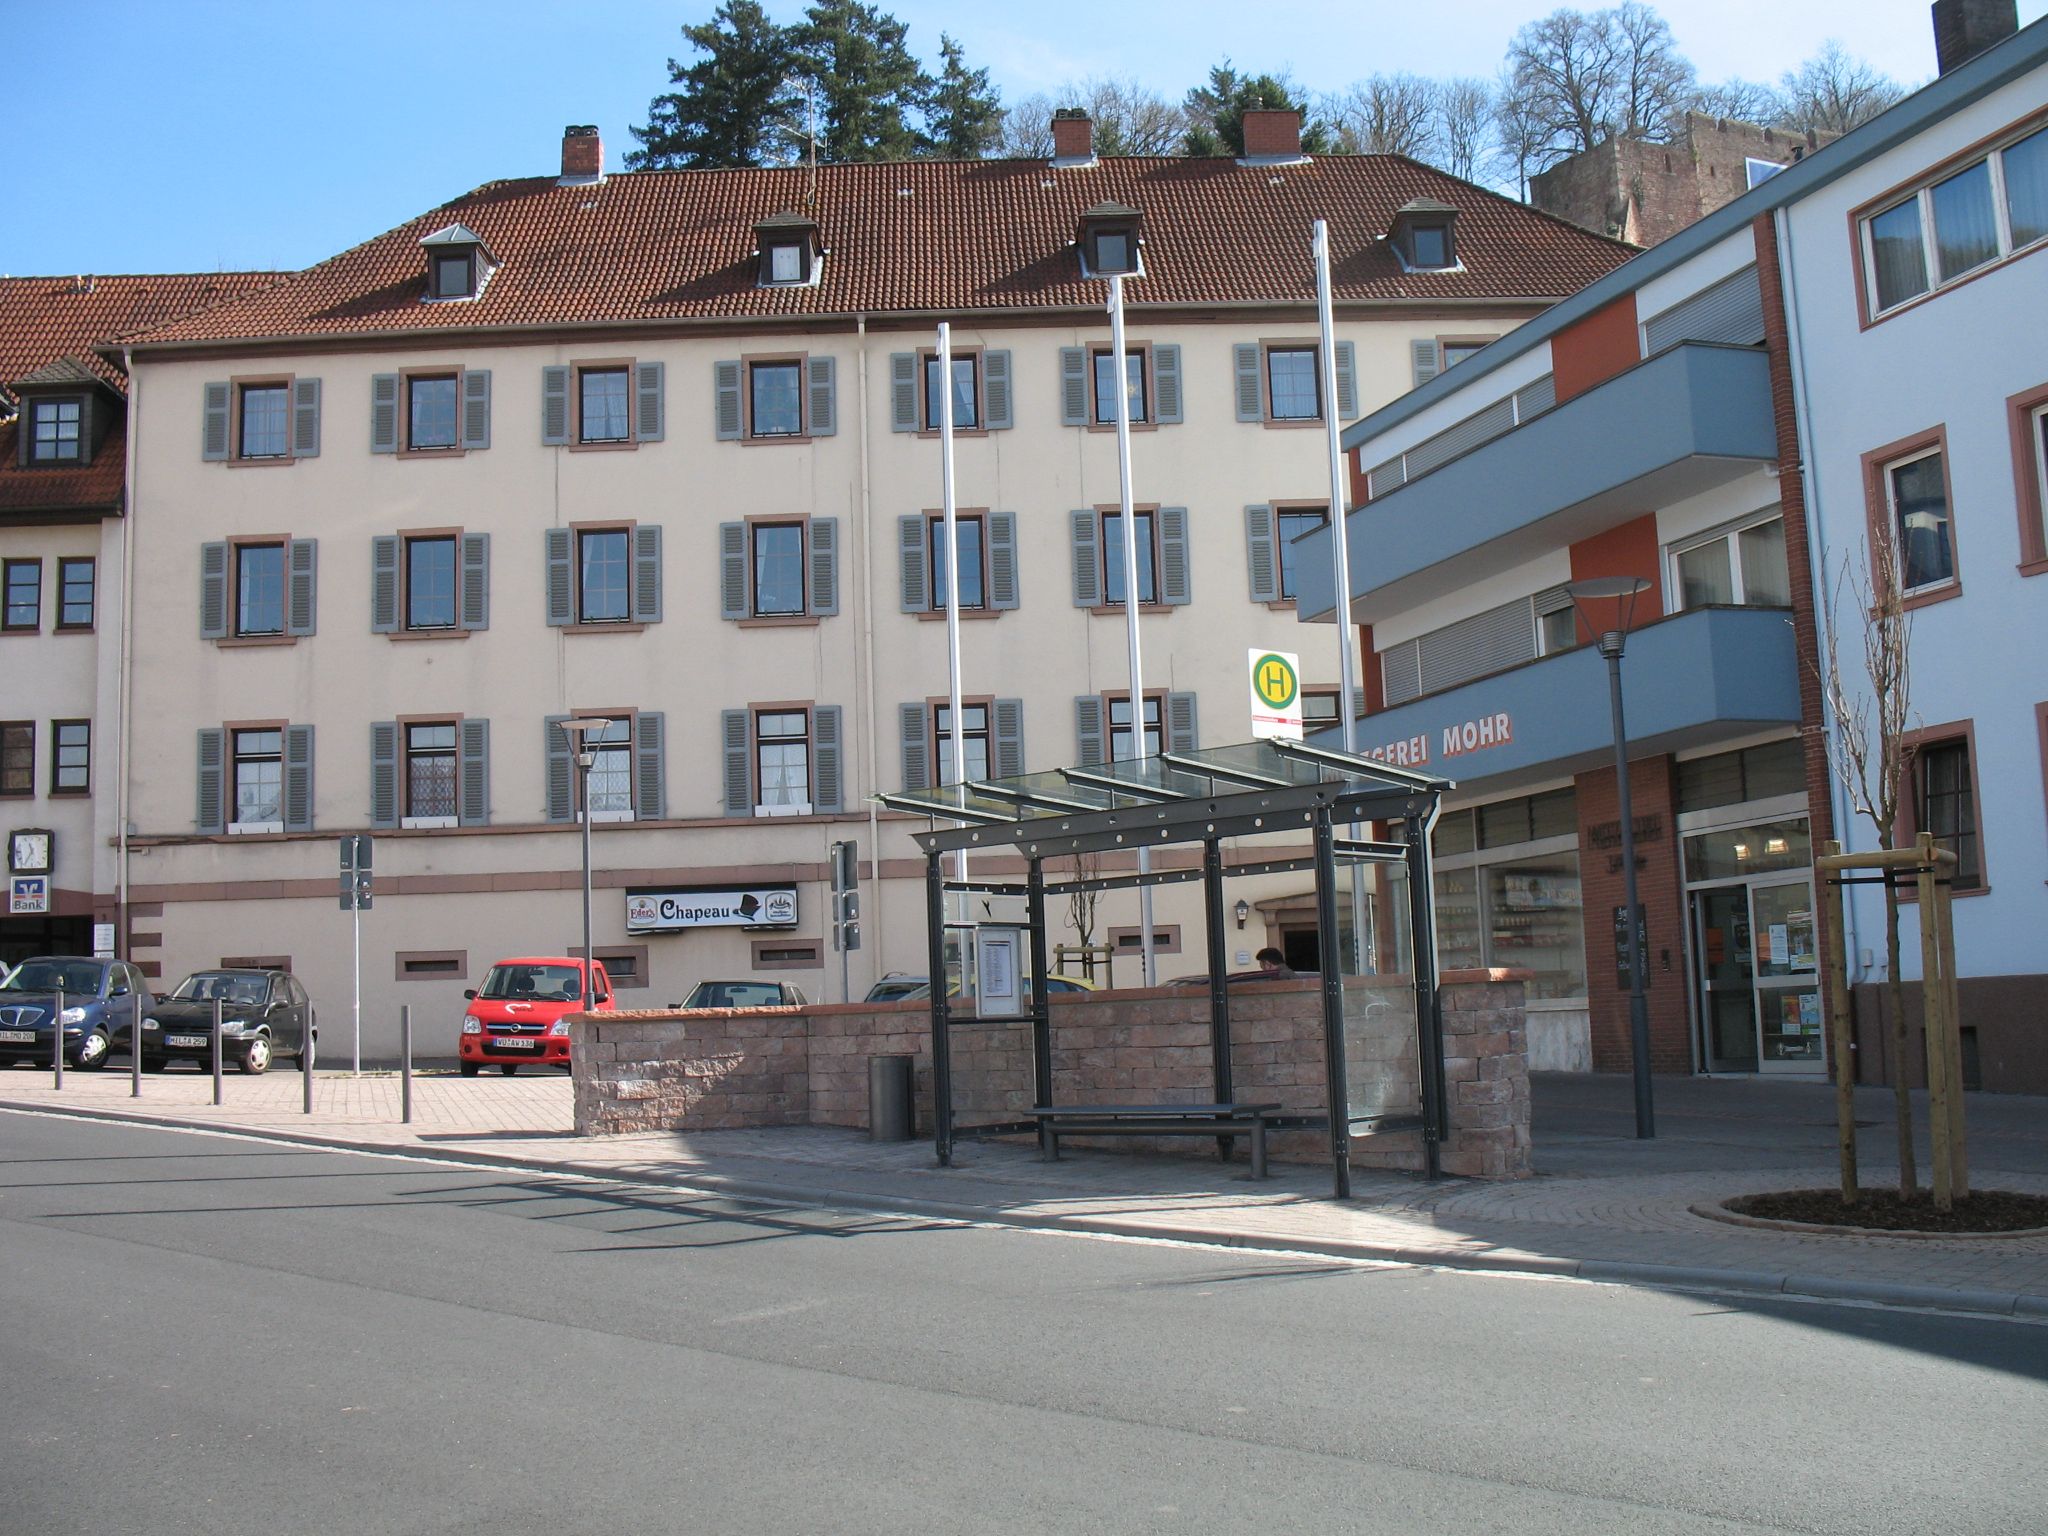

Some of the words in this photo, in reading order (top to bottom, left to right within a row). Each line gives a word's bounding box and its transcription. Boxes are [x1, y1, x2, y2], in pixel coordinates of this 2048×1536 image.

[1266, 666, 1285, 697] H
[1443, 713, 1511, 757] MOHR
[14, 900, 42, 910] Bank
[660, 899, 730, 921] Chapeau
